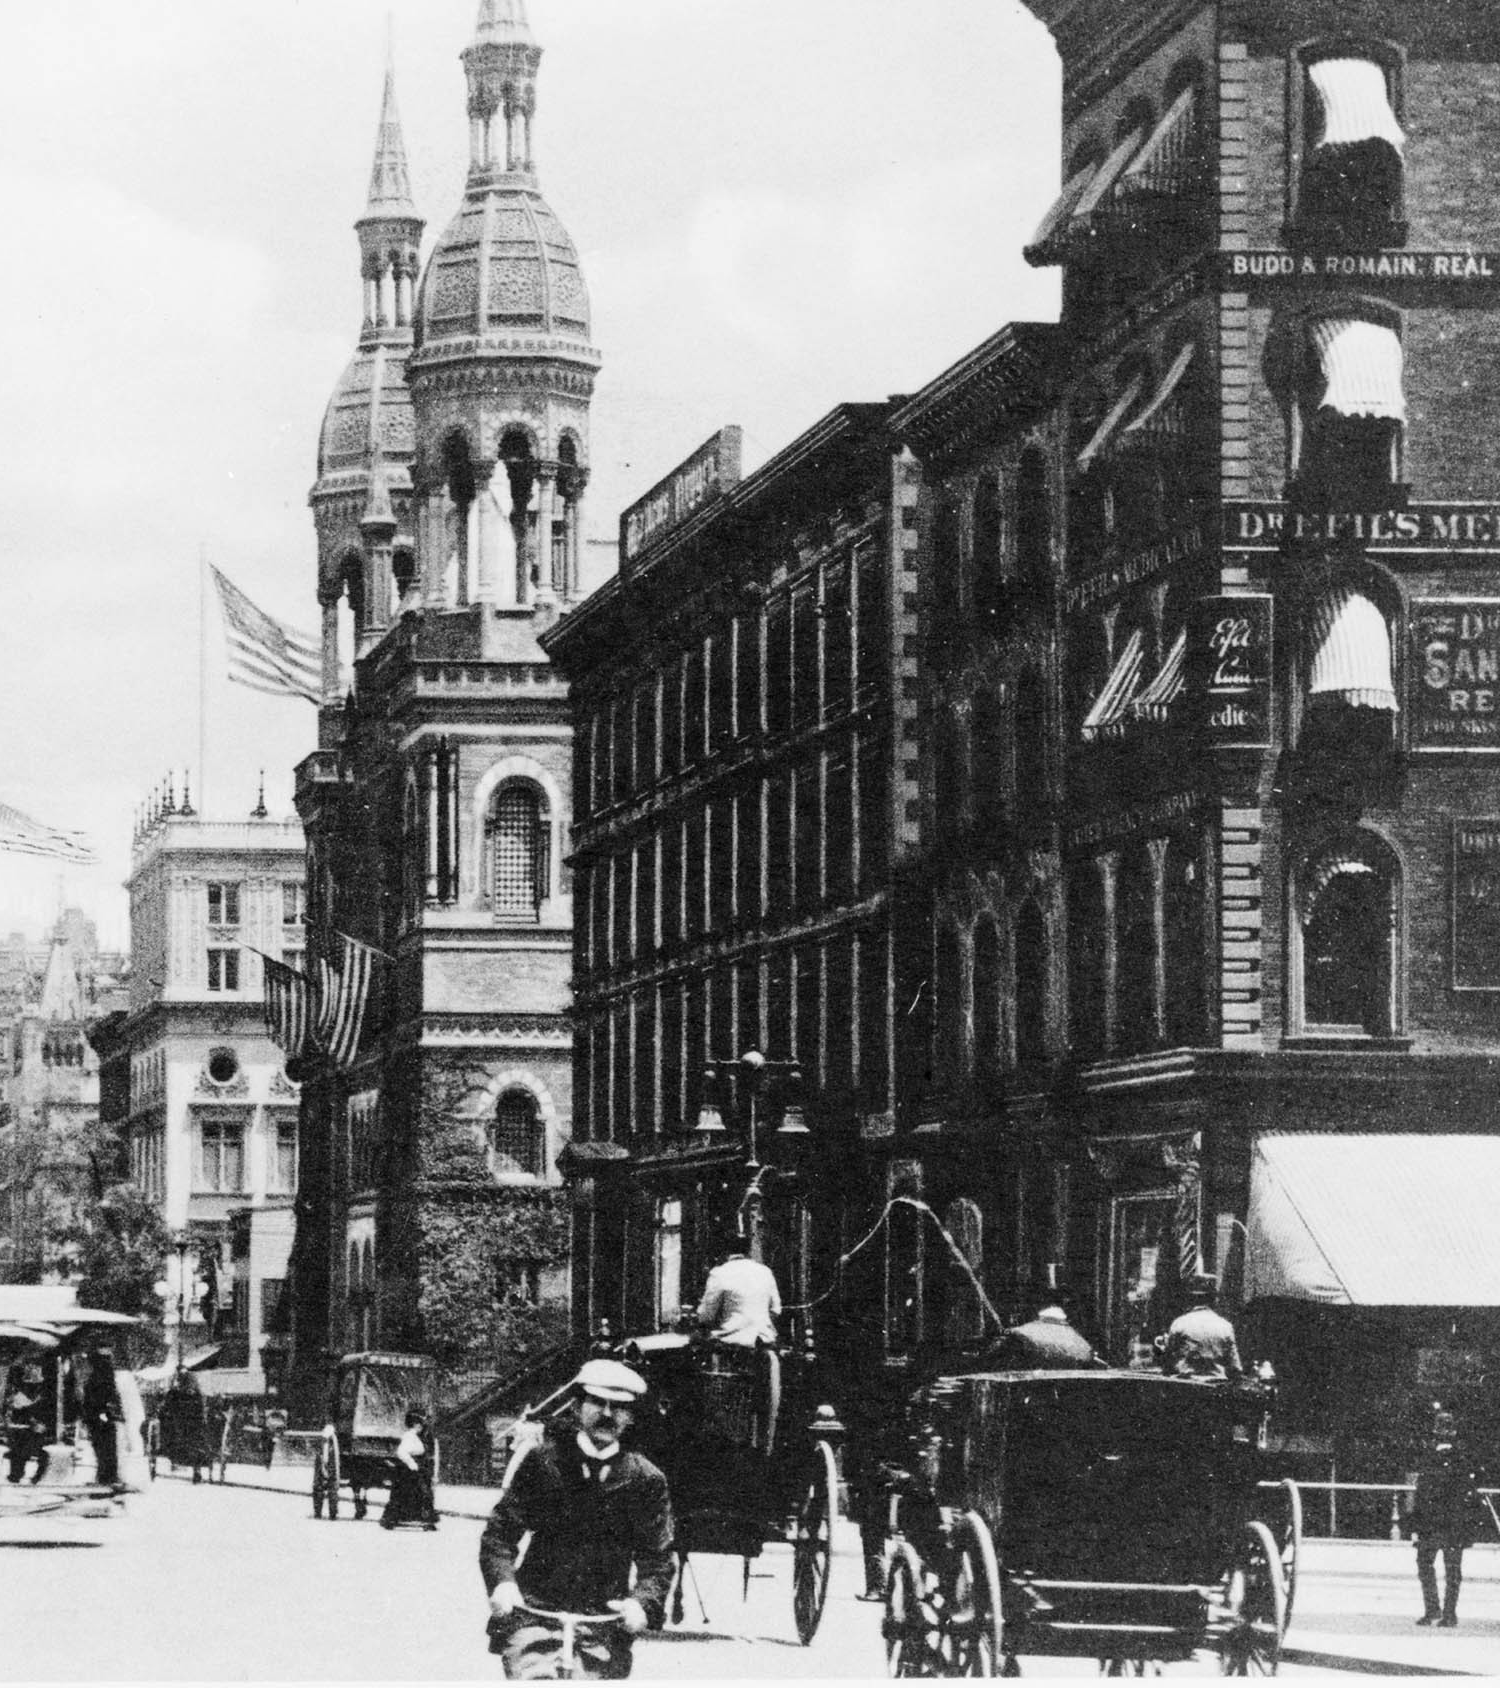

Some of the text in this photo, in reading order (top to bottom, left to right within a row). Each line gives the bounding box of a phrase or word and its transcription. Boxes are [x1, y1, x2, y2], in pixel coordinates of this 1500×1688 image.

[1234, 255, 1294, 275] BUDD
[1300, 255, 1316, 274] &
[1434, 255, 1492, 276] REAL
[1449, 689, 1495, 712] RE
